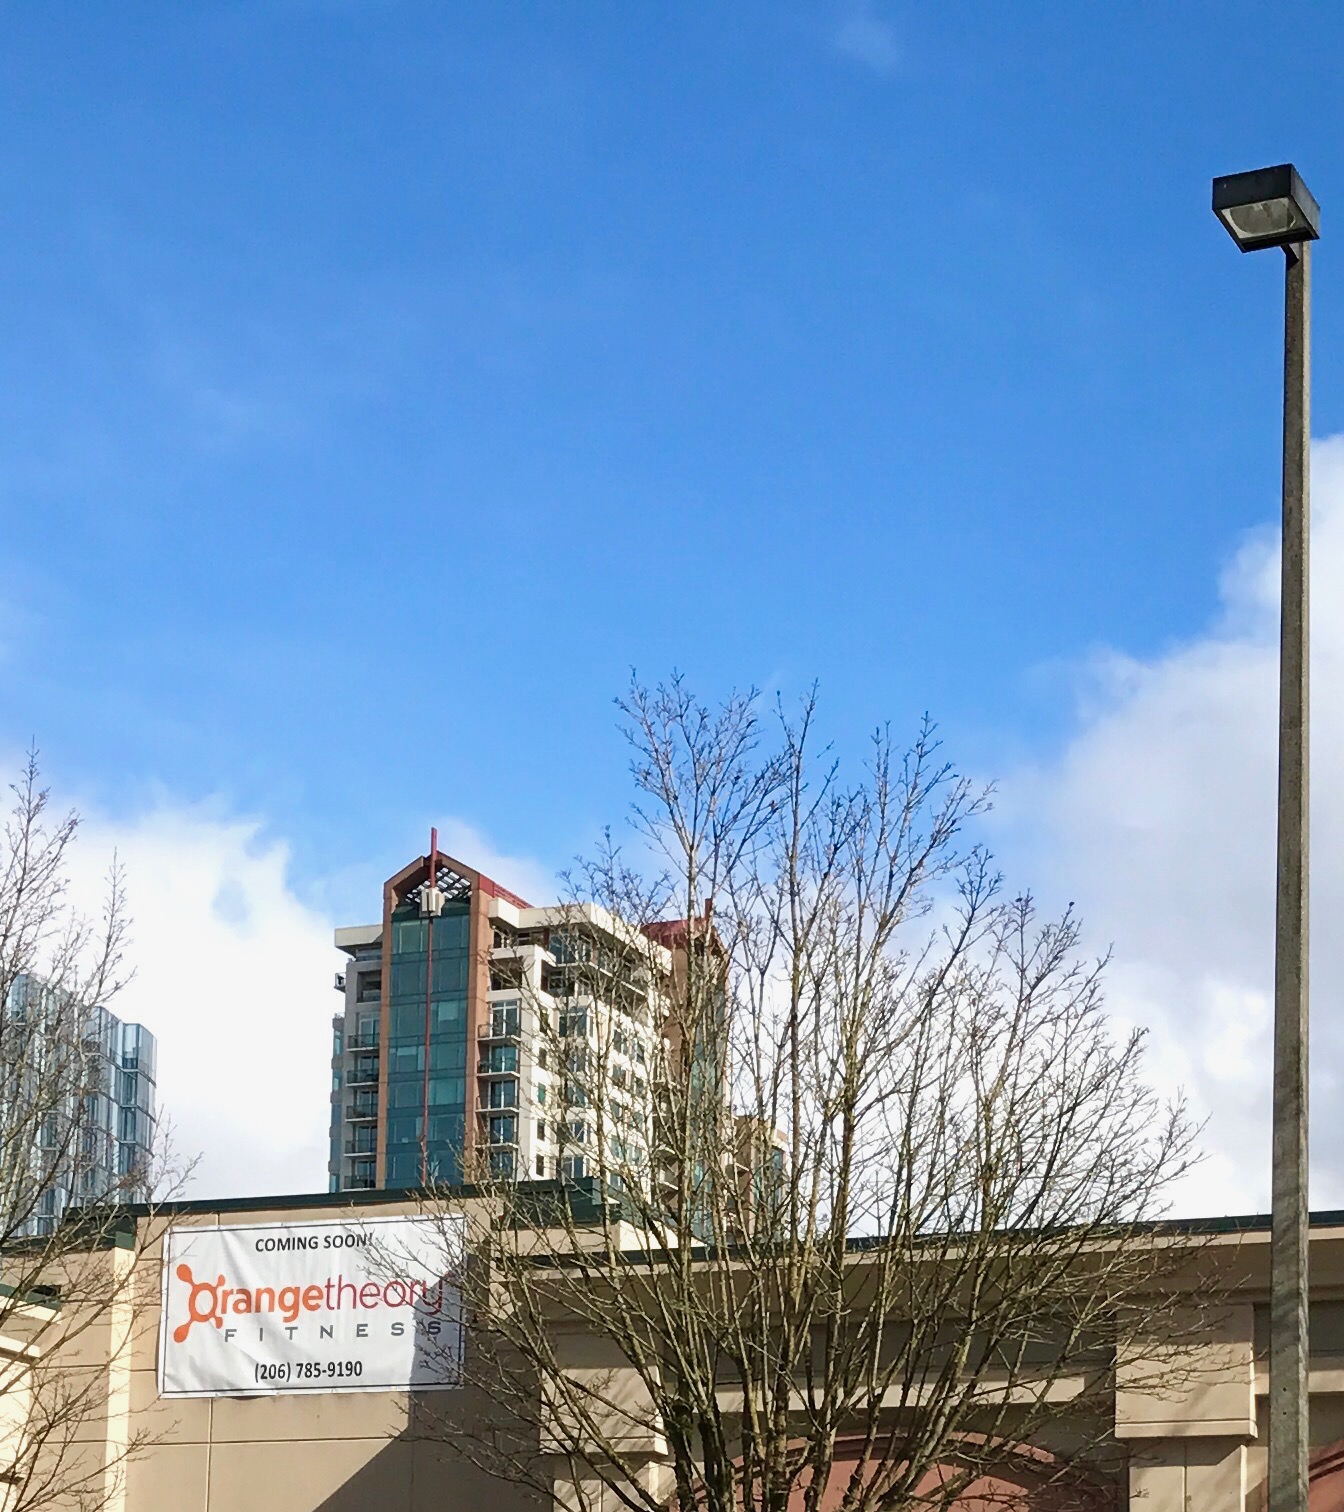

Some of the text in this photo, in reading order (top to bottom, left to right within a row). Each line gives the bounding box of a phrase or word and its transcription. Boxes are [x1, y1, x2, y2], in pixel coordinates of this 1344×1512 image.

[255, 1236, 319, 1253] COMING
[224, 1321, 442, 1342] FITNESS
[255, 1360, 362, 1383] (206) 785-9190
